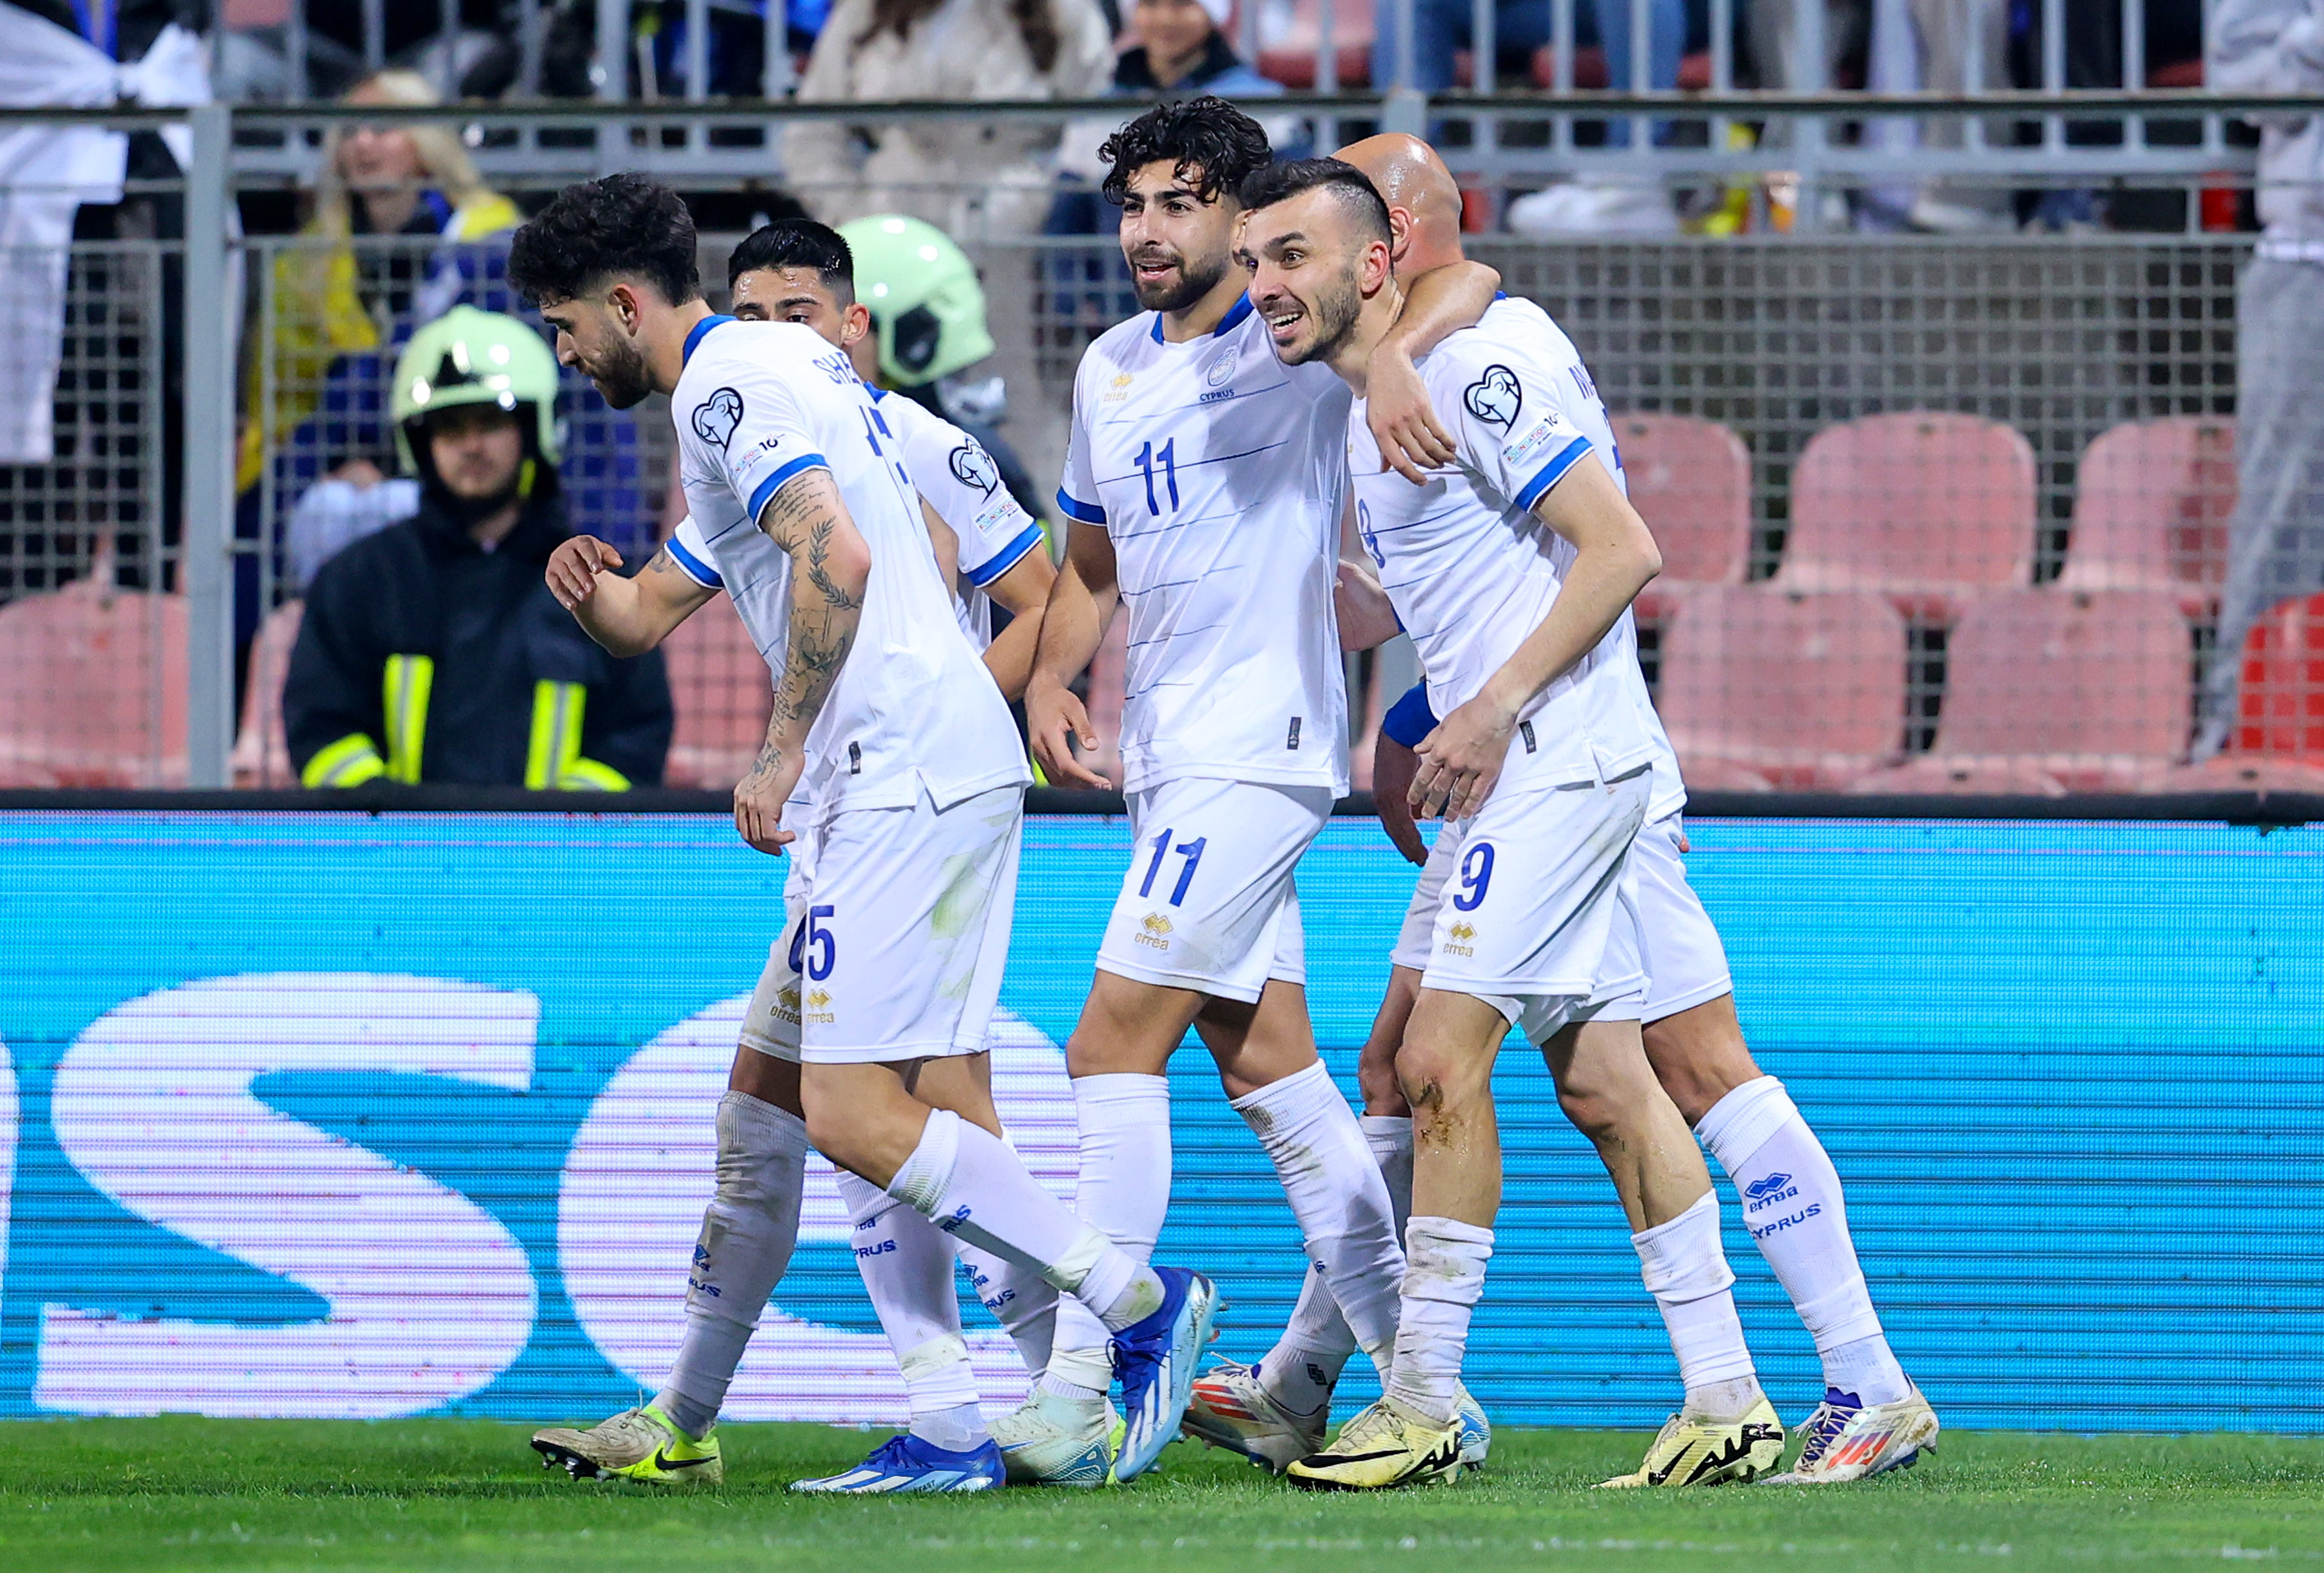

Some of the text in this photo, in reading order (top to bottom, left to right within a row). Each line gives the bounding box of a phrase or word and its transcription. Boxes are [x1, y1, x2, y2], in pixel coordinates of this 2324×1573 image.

[812, 352, 861, 385] SHE
[1200, 388, 1234, 401] CYPRUS
[1134, 437, 1179, 516] 11
[979, 500, 1014, 530] FOUNDATIO
[1139, 828, 1207, 907] 11
[1453, 842, 1495, 911] 9
[1134, 932, 1170, 950] errea
[1443, 943, 1475, 958] errea
[1749, 1186, 1799, 1213] errea
[1752, 1203, 1822, 1239] YPRUS
[853, 1240, 897, 1258] PRUS
